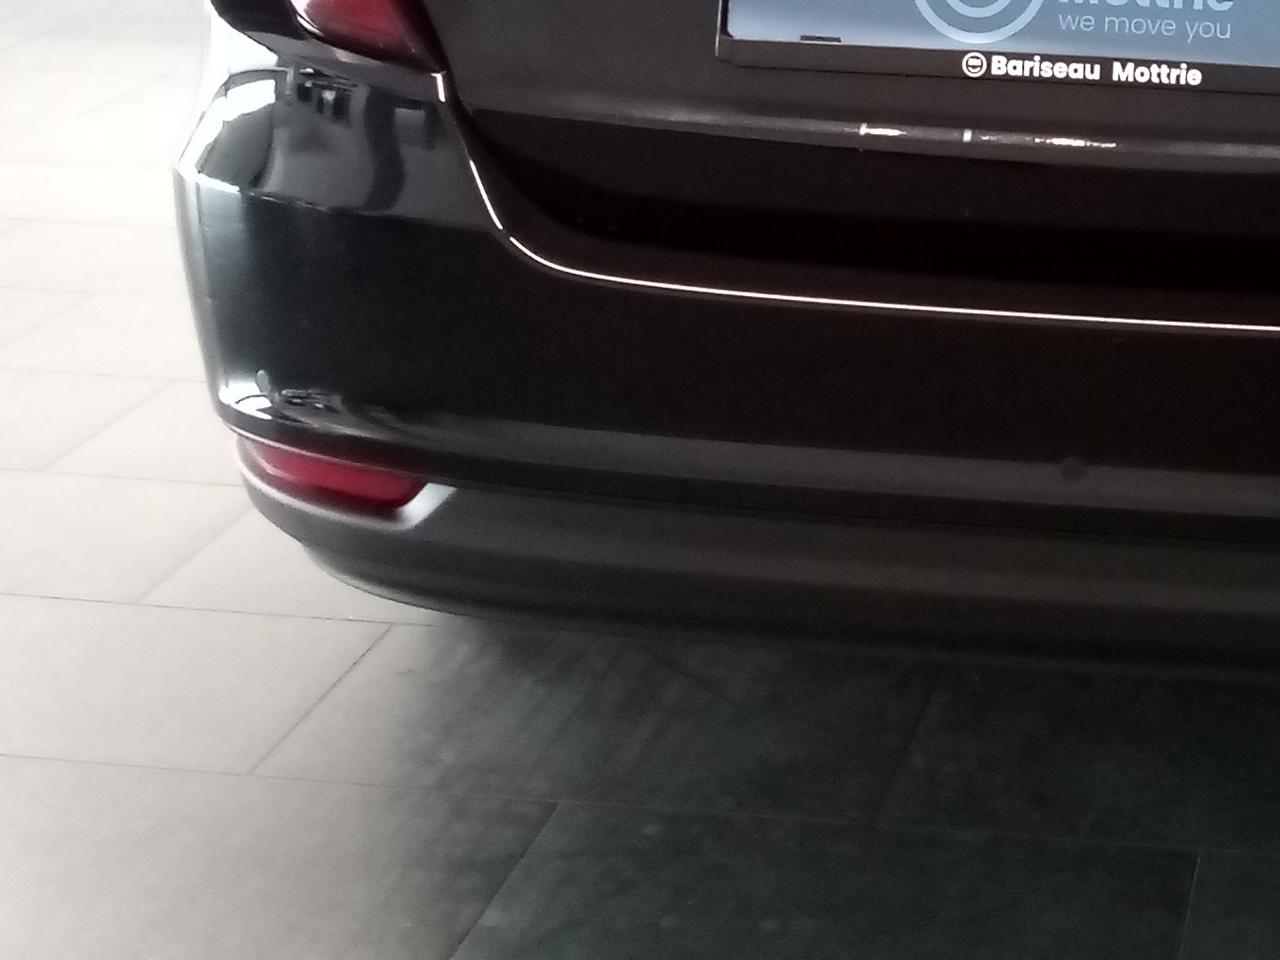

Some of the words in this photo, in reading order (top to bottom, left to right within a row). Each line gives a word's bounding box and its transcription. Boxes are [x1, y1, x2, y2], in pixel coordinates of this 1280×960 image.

[1058, 14, 1095, 32] we
[1104, 16, 1176, 35] move
[1185, 20, 1231, 43] you
[991, 55, 1101, 80] Bariseau
[1112, 61, 1203, 86] Mottrie
